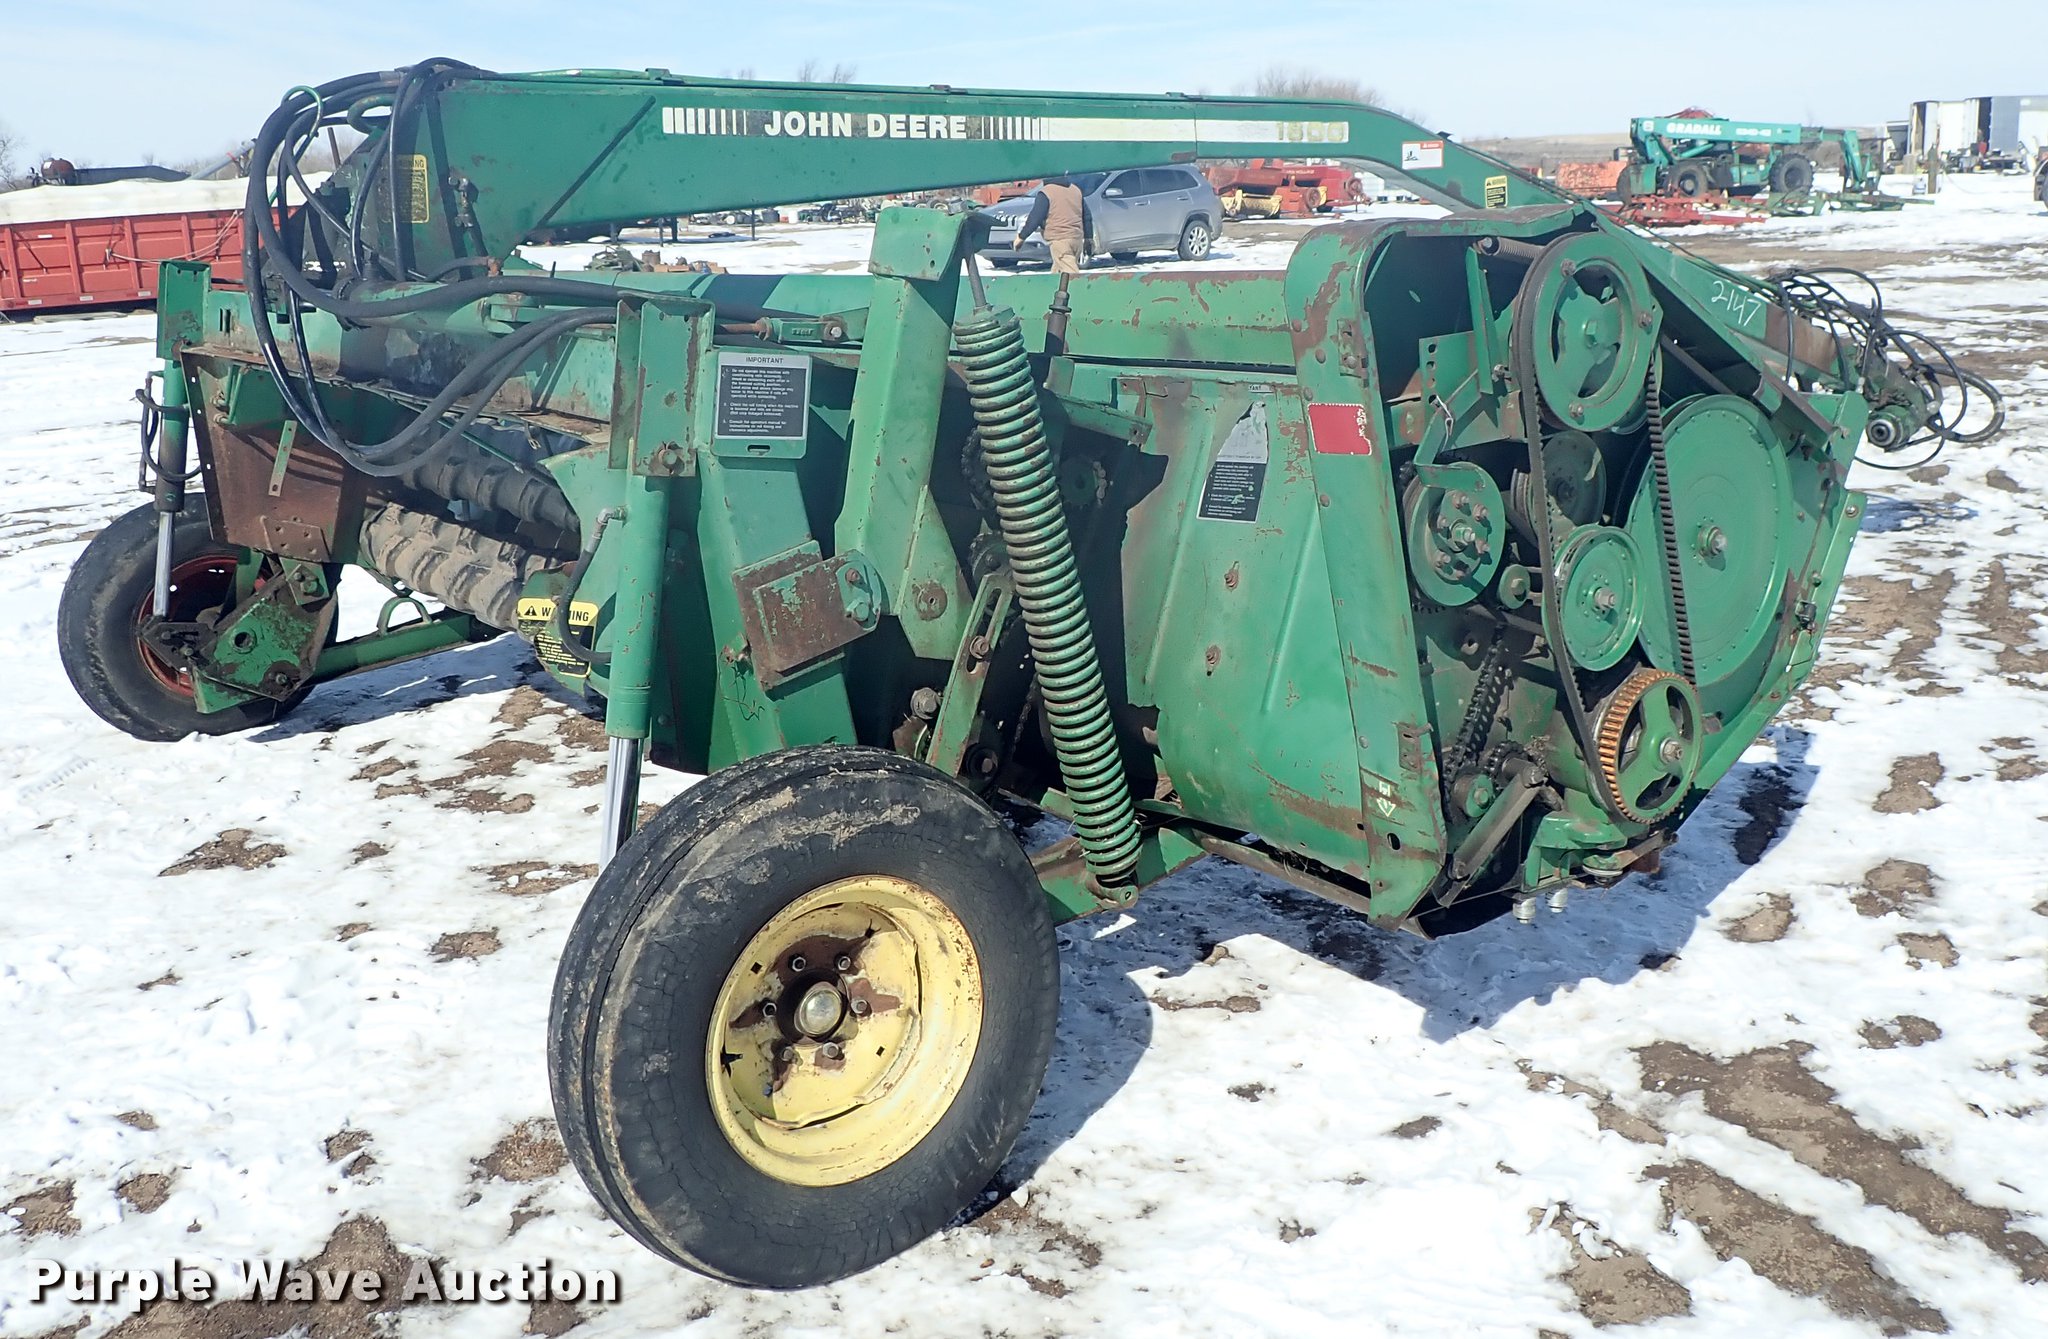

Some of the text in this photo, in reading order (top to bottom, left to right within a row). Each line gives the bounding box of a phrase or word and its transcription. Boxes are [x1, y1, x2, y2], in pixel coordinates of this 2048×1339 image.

[764, 111, 967, 139] JOHN DEERE
[1666, 122, 1722, 135] GRADALL
[1711, 280, 1761, 326] 2147
[541, 606, 589, 622] WING
